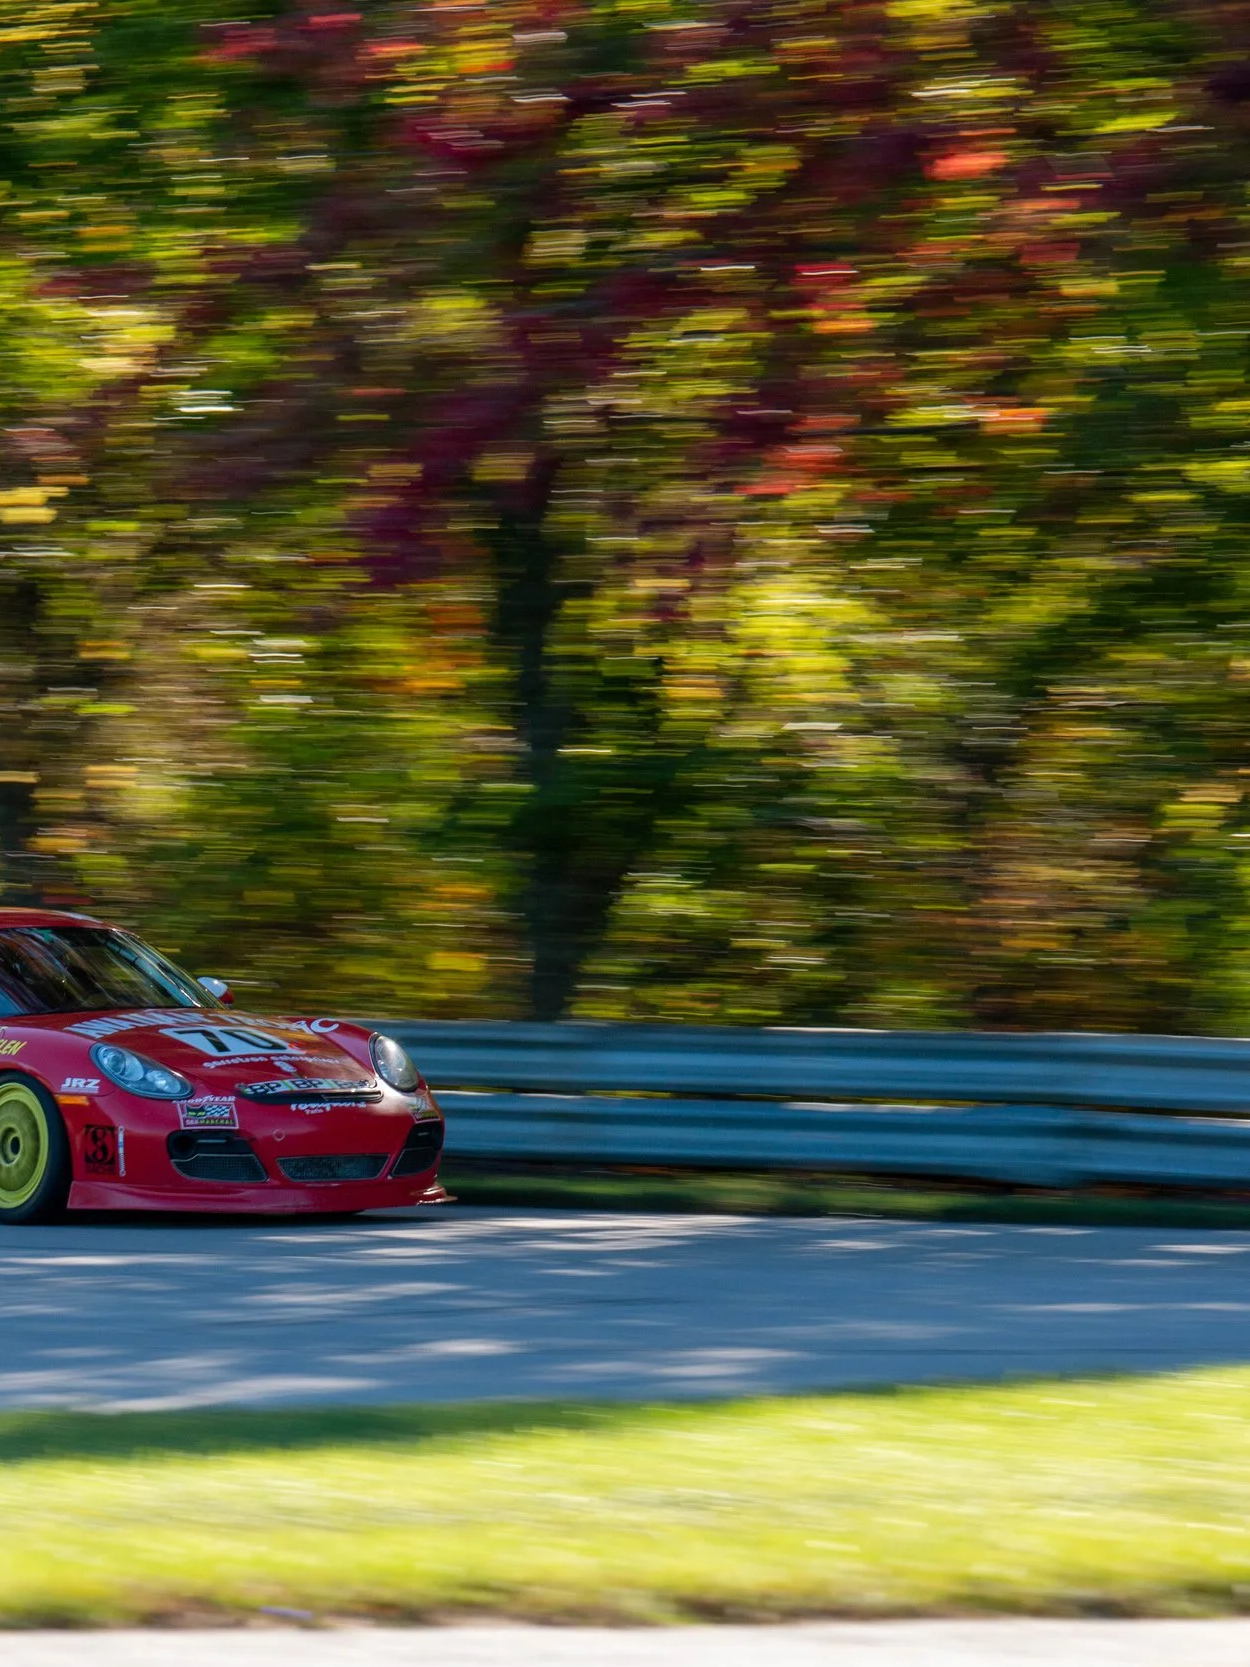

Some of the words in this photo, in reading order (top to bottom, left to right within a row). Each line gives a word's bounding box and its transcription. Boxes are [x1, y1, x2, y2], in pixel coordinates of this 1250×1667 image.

[173, 1028, 287, 1052] 70
[62, 1077, 101, 1088] JRZ
[290, 1078, 324, 1089] BP
